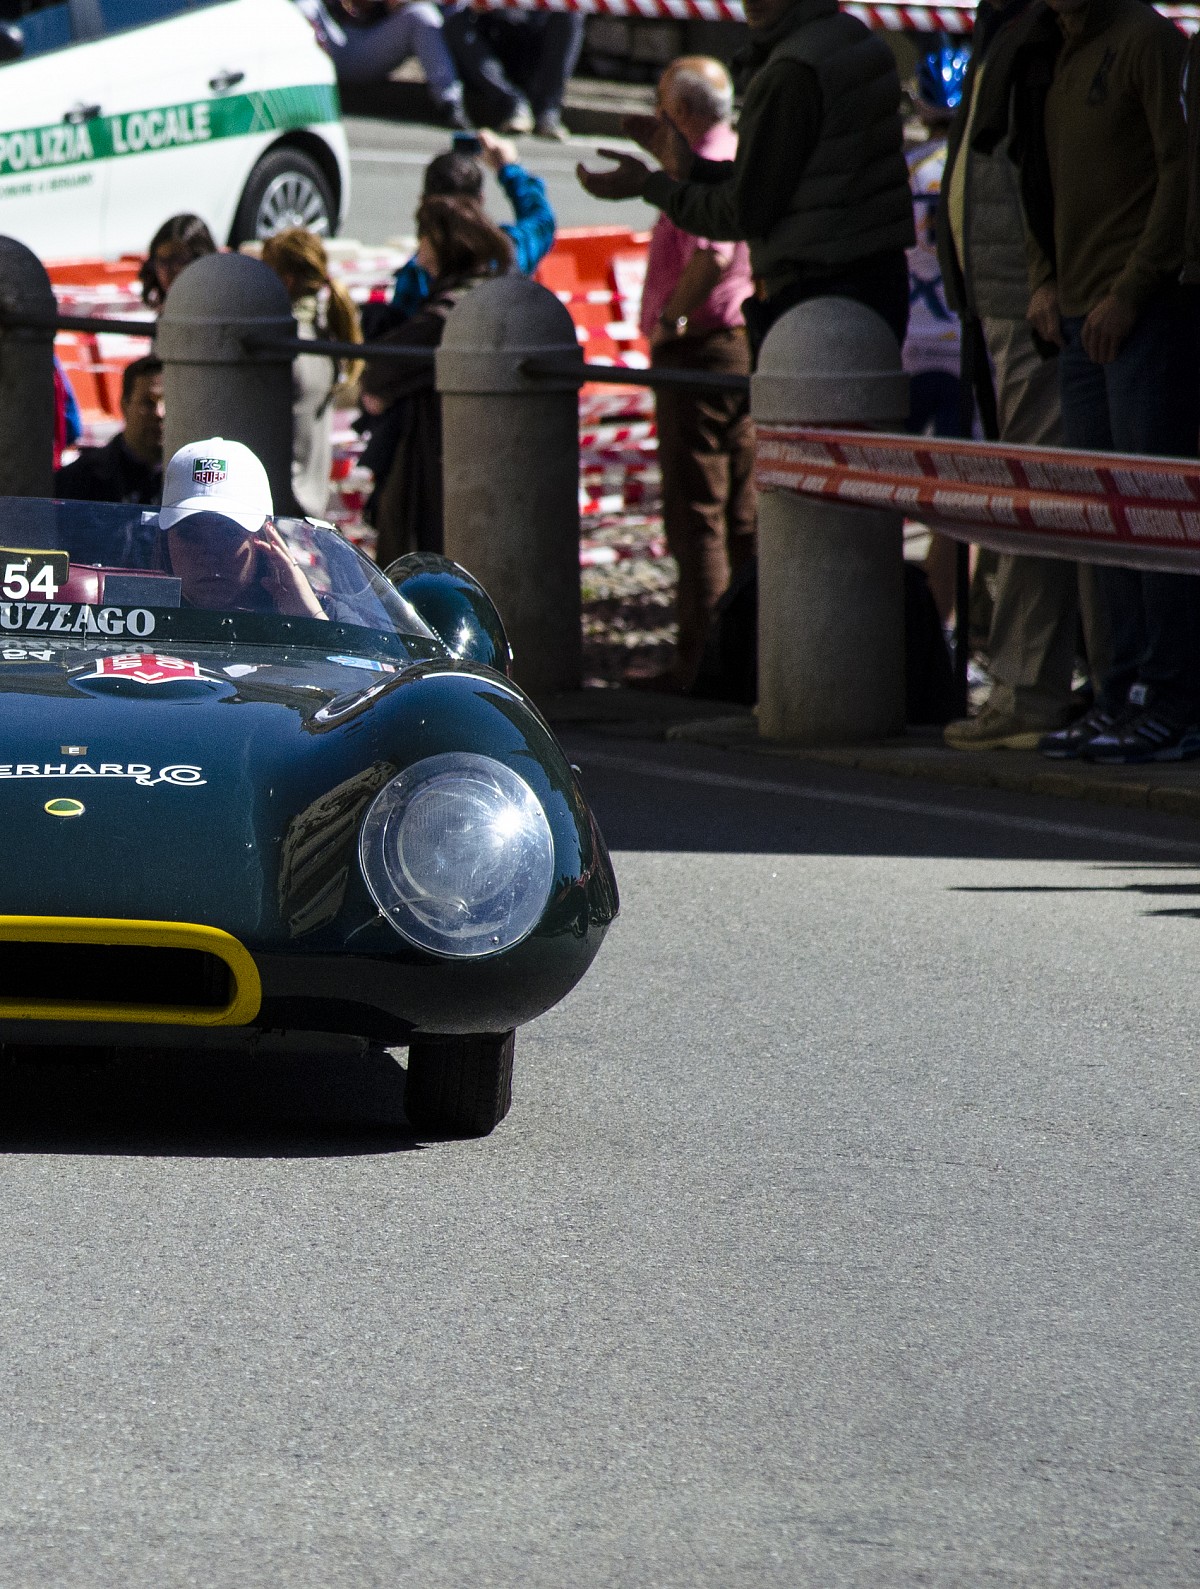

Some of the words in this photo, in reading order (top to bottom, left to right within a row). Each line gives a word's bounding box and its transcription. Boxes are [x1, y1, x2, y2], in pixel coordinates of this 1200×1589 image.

[111, 102, 211, 154] LOCALE
[194, 471, 227, 484] HEUER
[2, 563, 59, 600] 54
